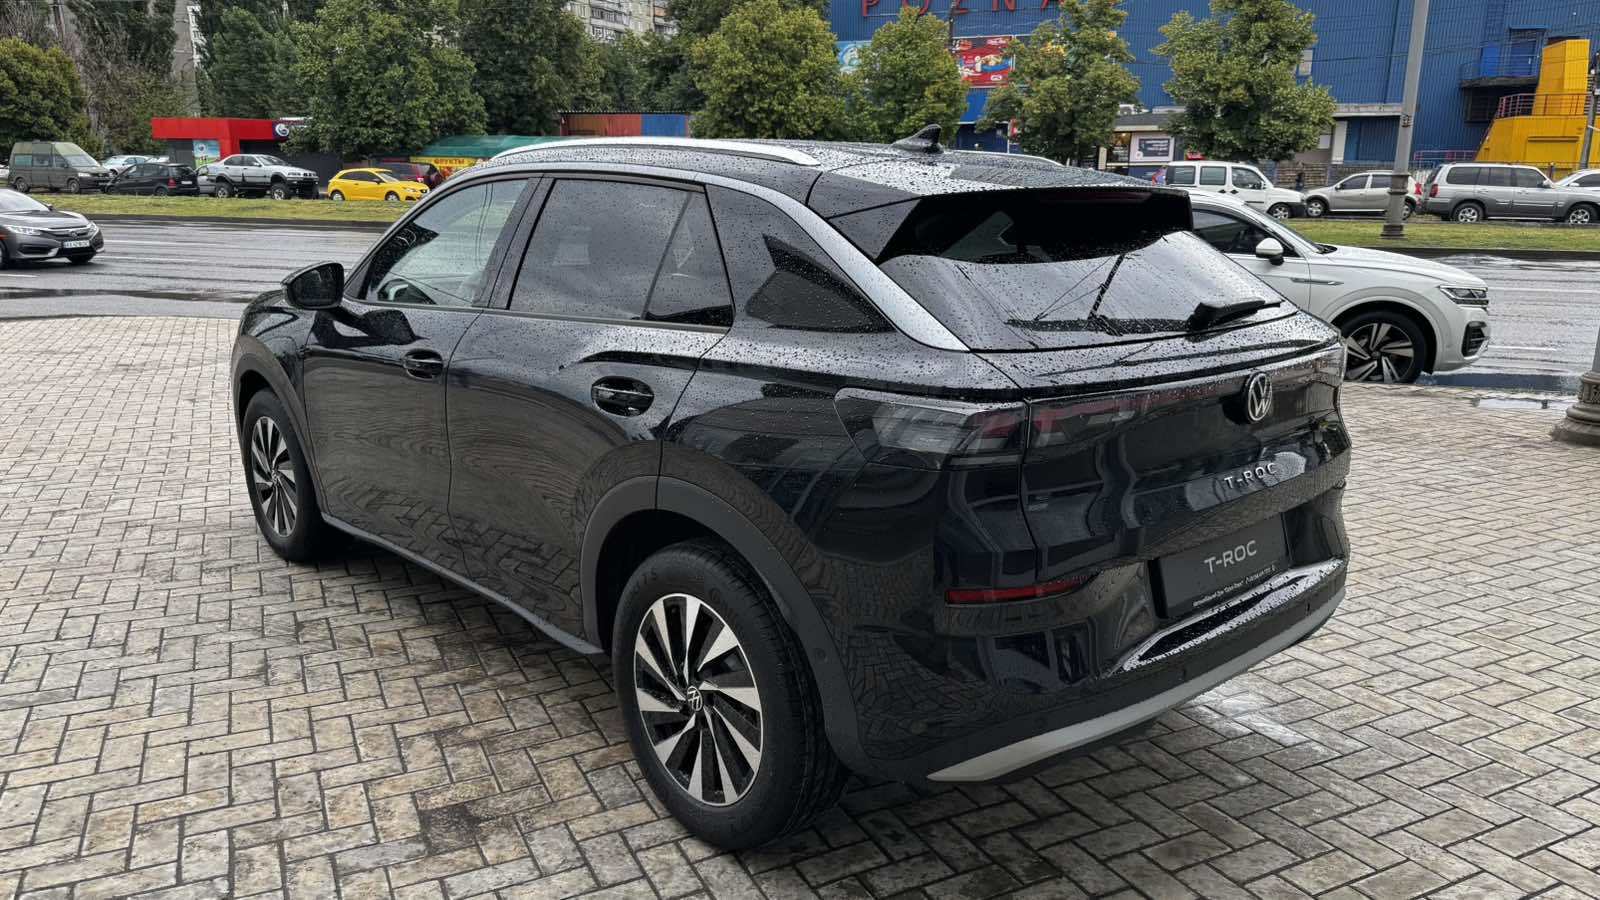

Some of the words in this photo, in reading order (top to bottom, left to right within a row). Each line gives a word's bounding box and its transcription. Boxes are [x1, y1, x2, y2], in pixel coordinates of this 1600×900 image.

[863, 0, 1063, 17] POZ
[1223, 462, 1277, 489] T-ROC
[1204, 540, 1257, 573] T-ROC
